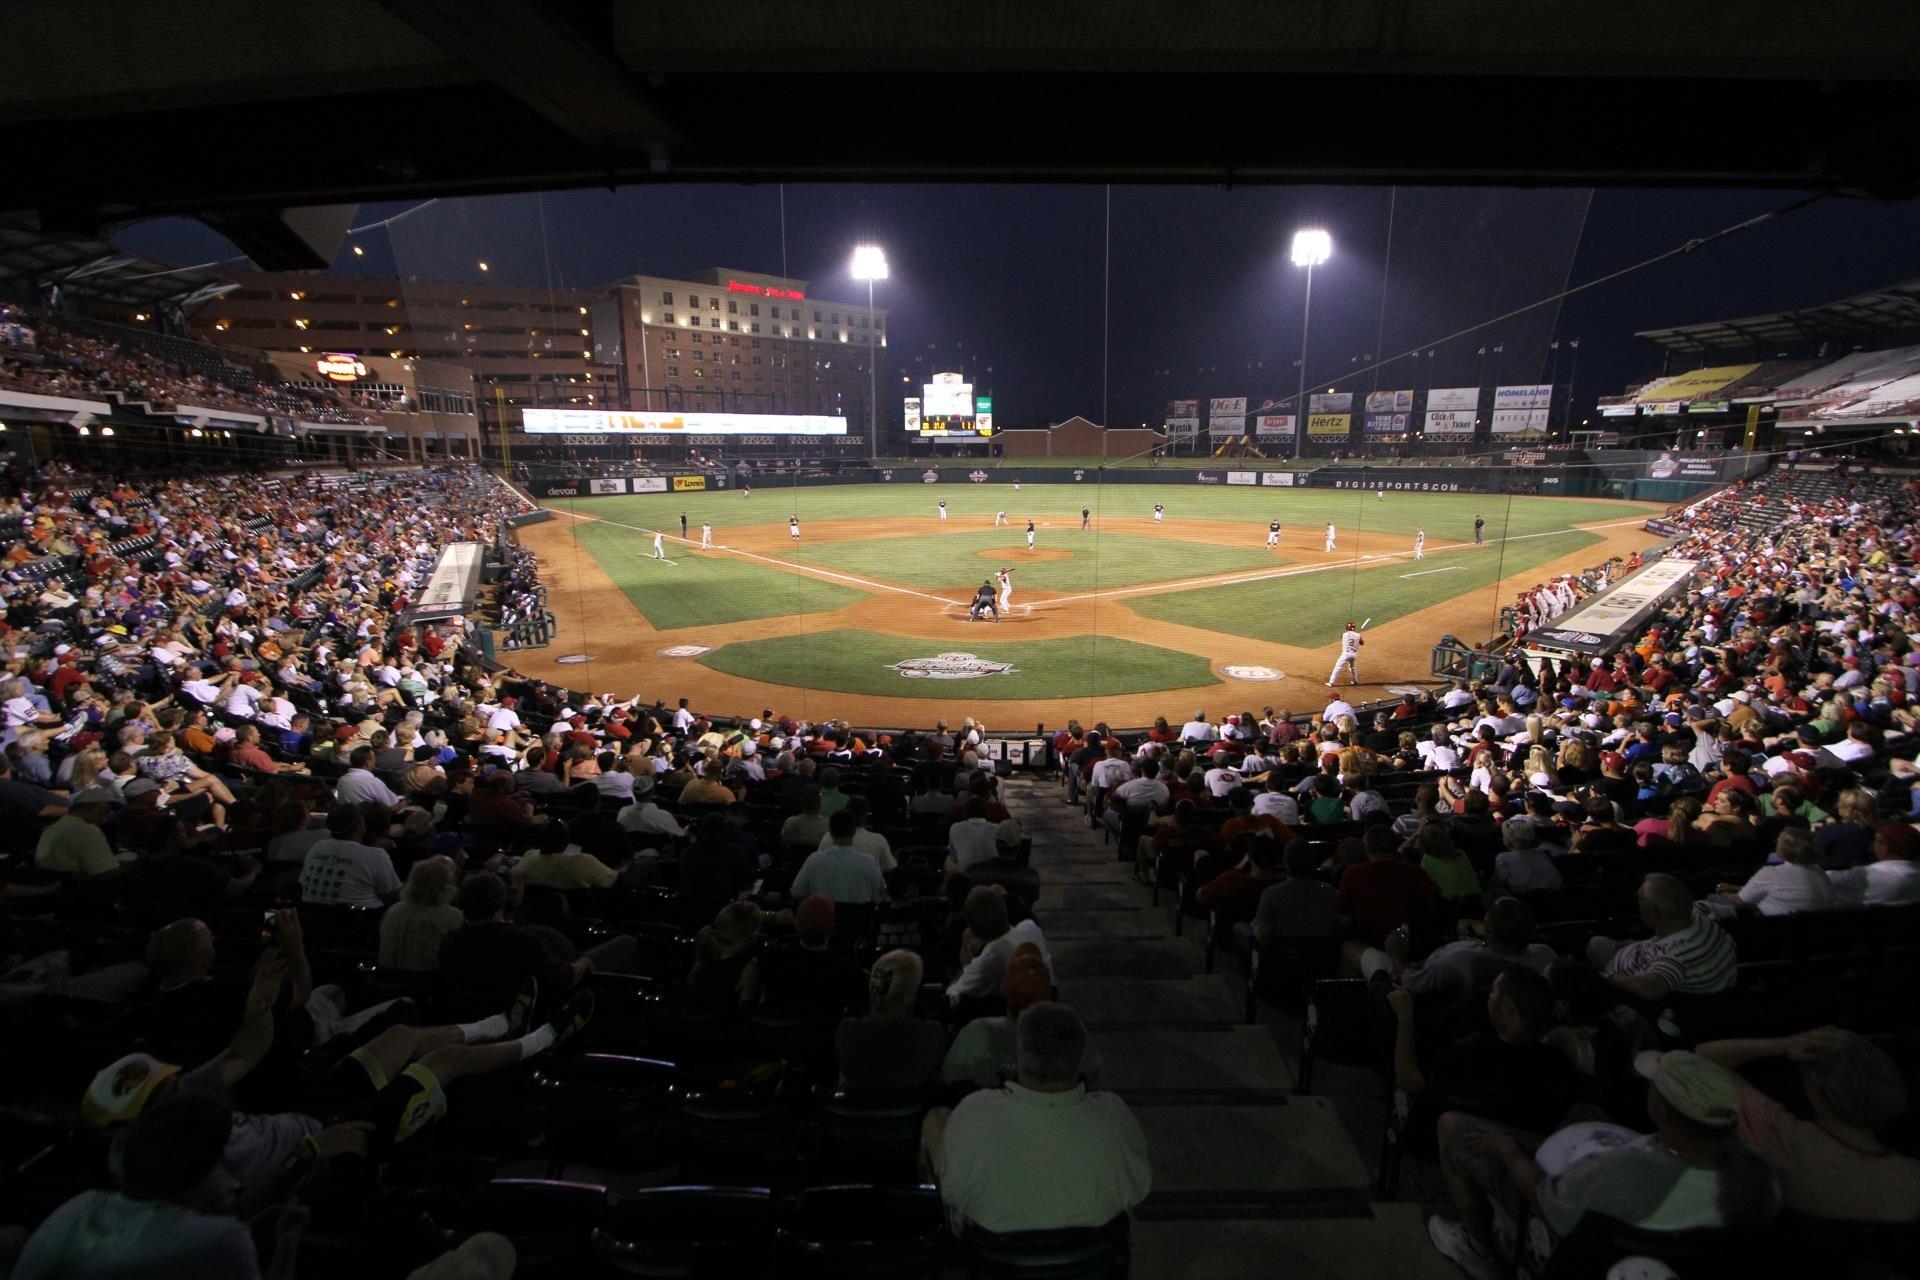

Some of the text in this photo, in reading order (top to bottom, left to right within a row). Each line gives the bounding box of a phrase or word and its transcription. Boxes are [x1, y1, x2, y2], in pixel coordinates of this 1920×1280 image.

[1498, 388, 1549, 397] HOMELAND
[1311, 417, 1342, 427] Hertz
[1452, 420, 1471, 429] Ticket
[684, 479, 704, 487] Love's
[547, 487, 577, 496] devon
